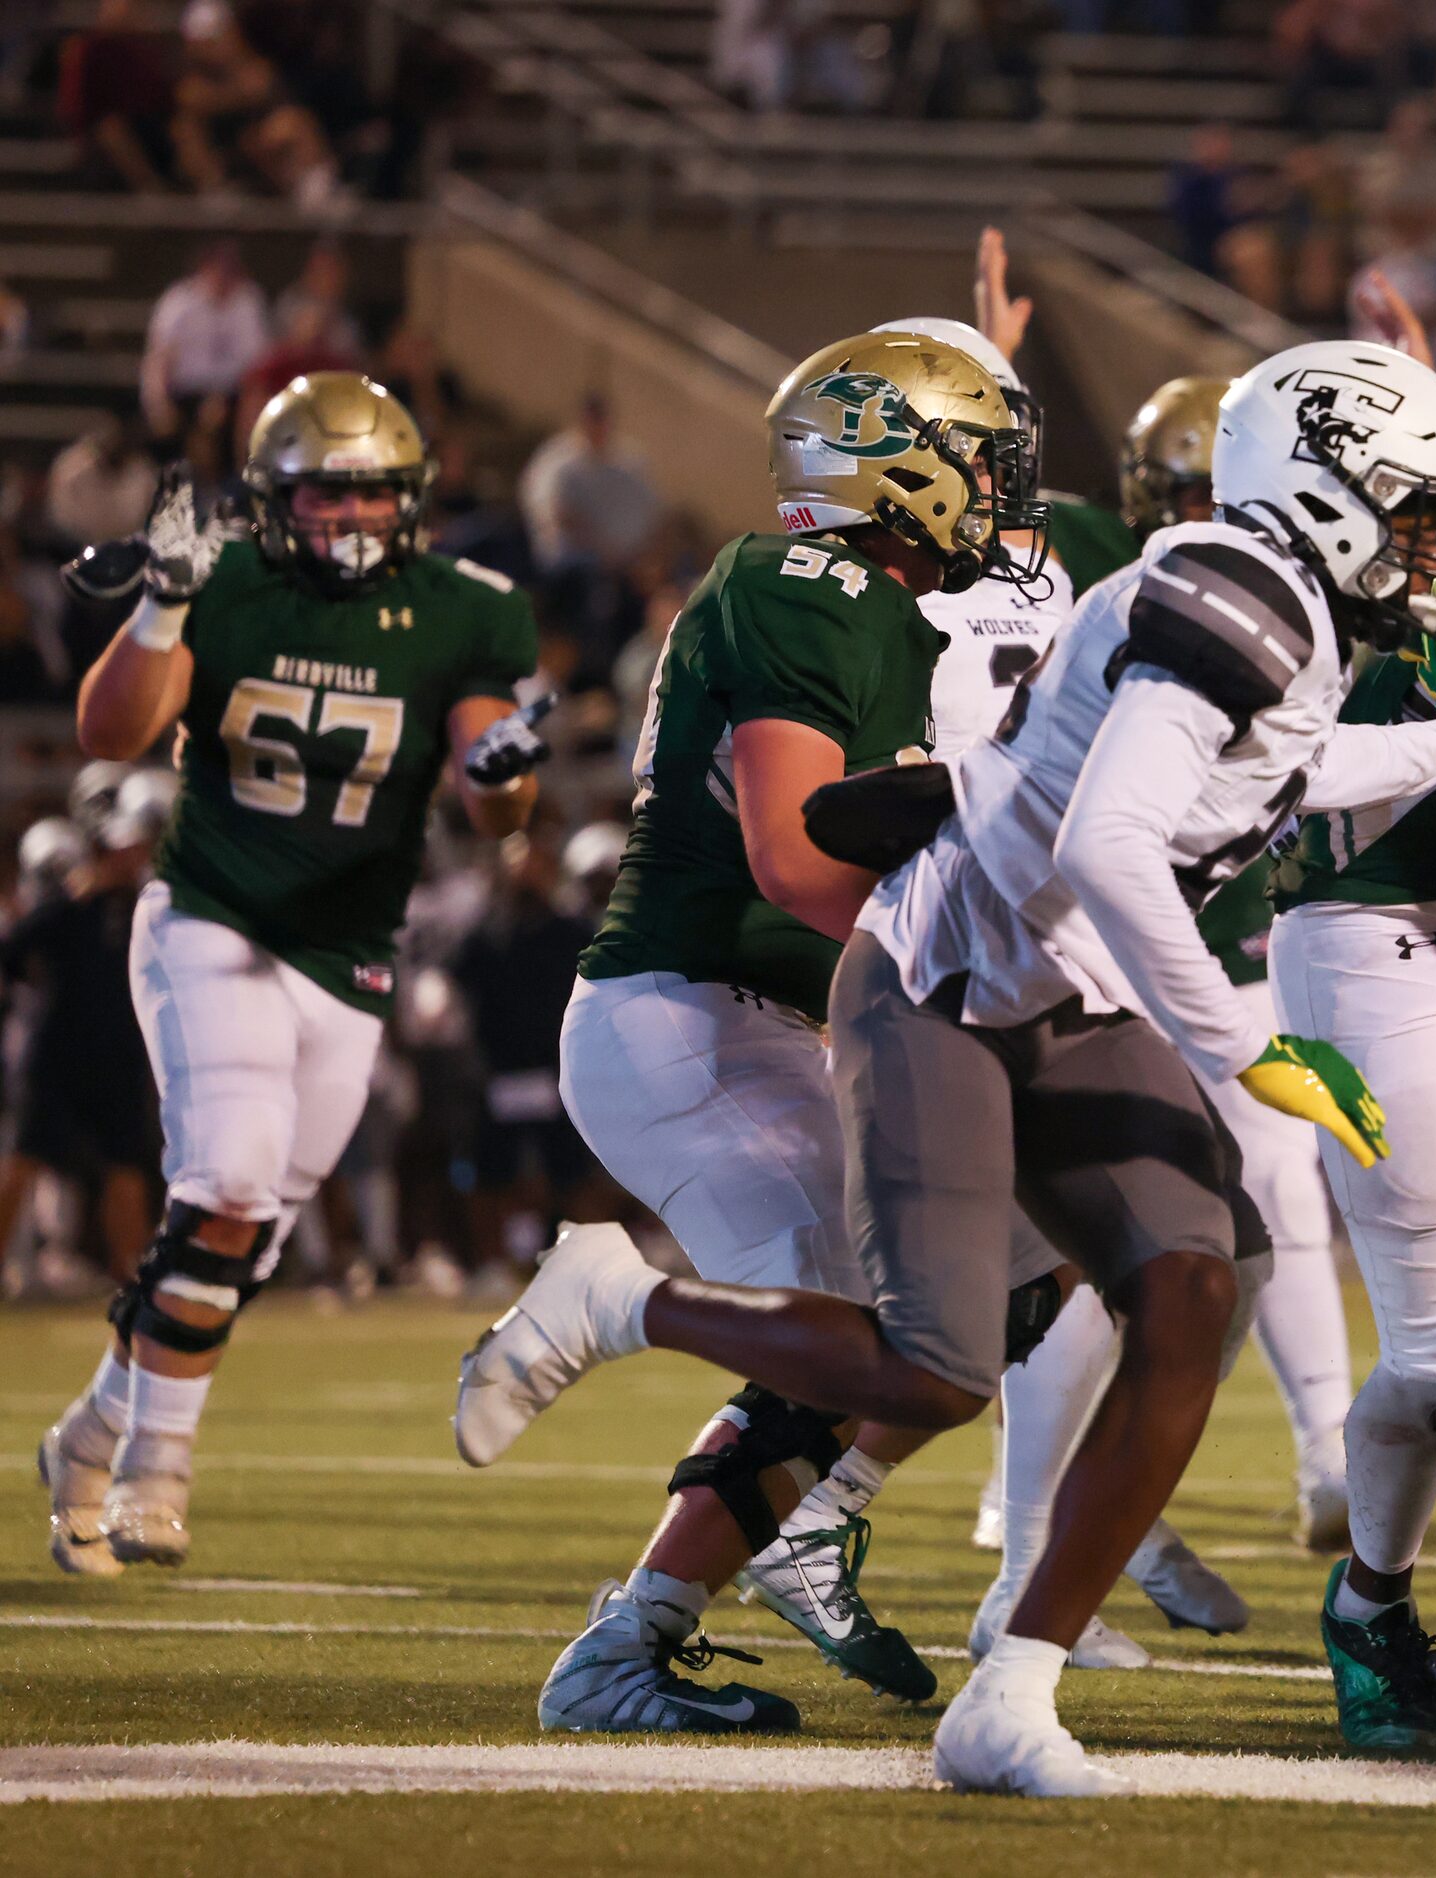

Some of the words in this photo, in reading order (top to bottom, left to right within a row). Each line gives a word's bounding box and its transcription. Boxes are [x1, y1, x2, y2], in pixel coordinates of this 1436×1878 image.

[780, 544, 869, 599] 54
[966, 619, 1039, 636] WOLVES
[272, 654, 378, 694] BIRDVILLE
[219, 677, 404, 827] 67
